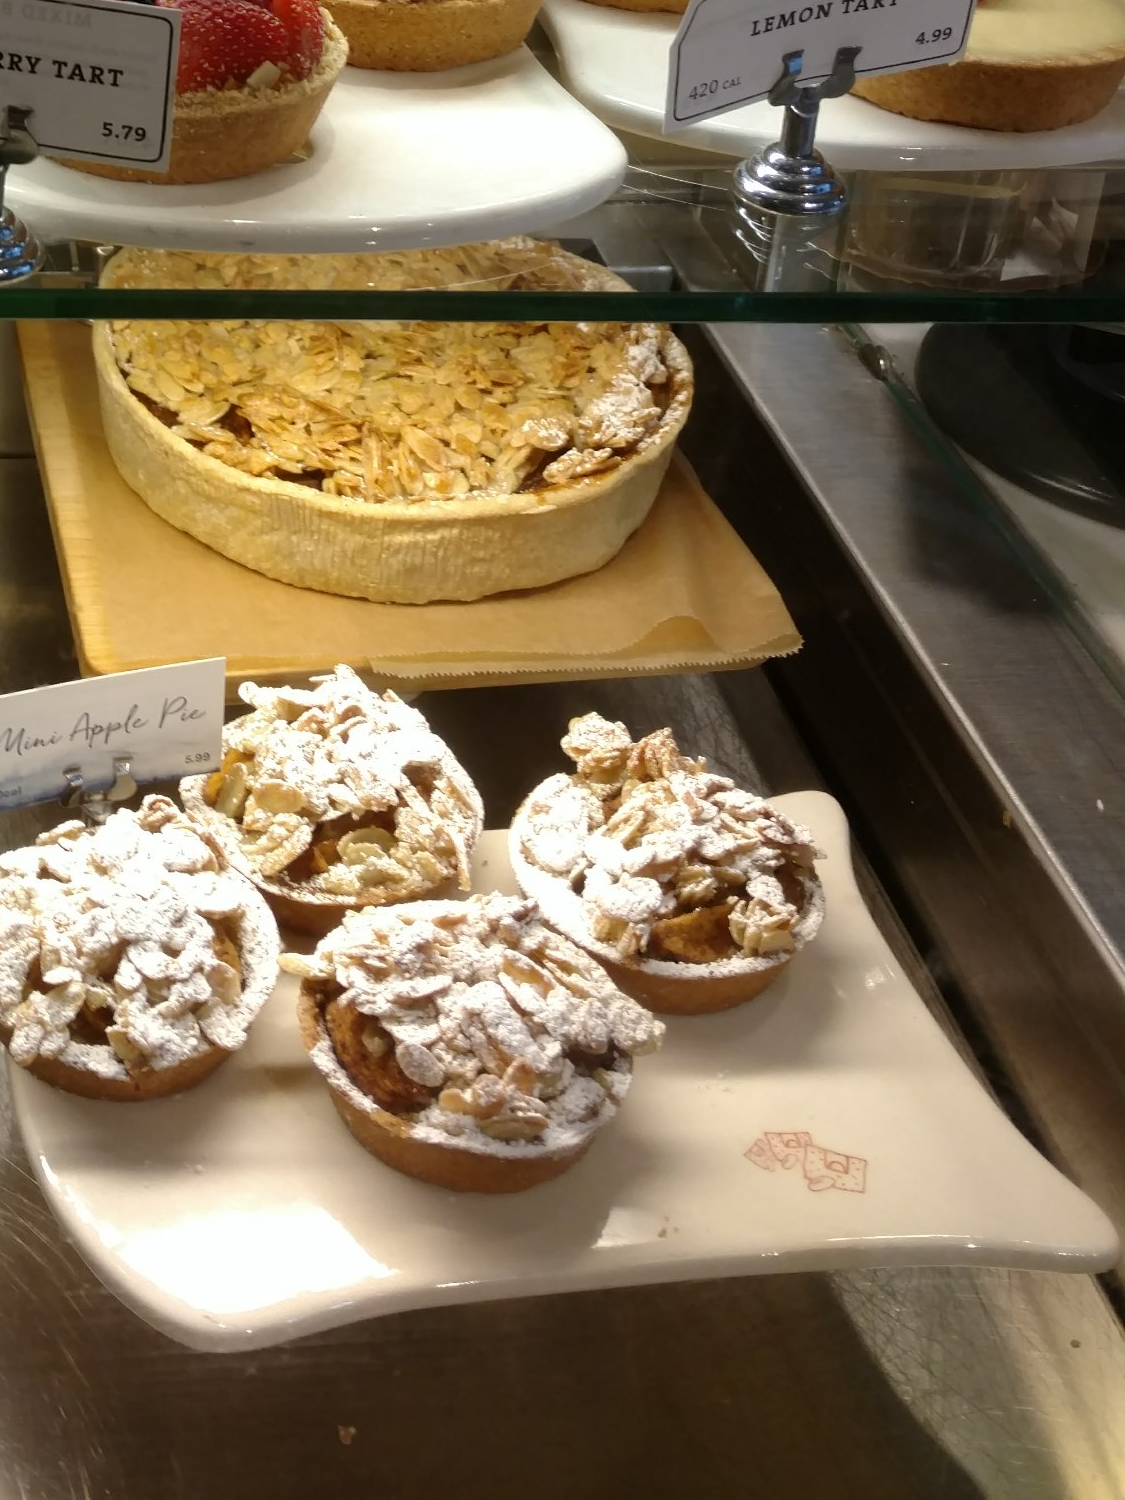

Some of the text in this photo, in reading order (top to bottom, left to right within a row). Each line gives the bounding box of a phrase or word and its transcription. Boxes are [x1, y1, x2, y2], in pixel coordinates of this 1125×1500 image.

[750, 2, 833, 36] LEMON
[915, 27, 952, 45] 4.99
[52, 60, 124, 87] TART
[689, 76, 742, 100] 420 CAL
[101, 121, 147, 142] 5.79
[69, 704, 149, 748] Apple
[159, 696, 207, 729] Pie
